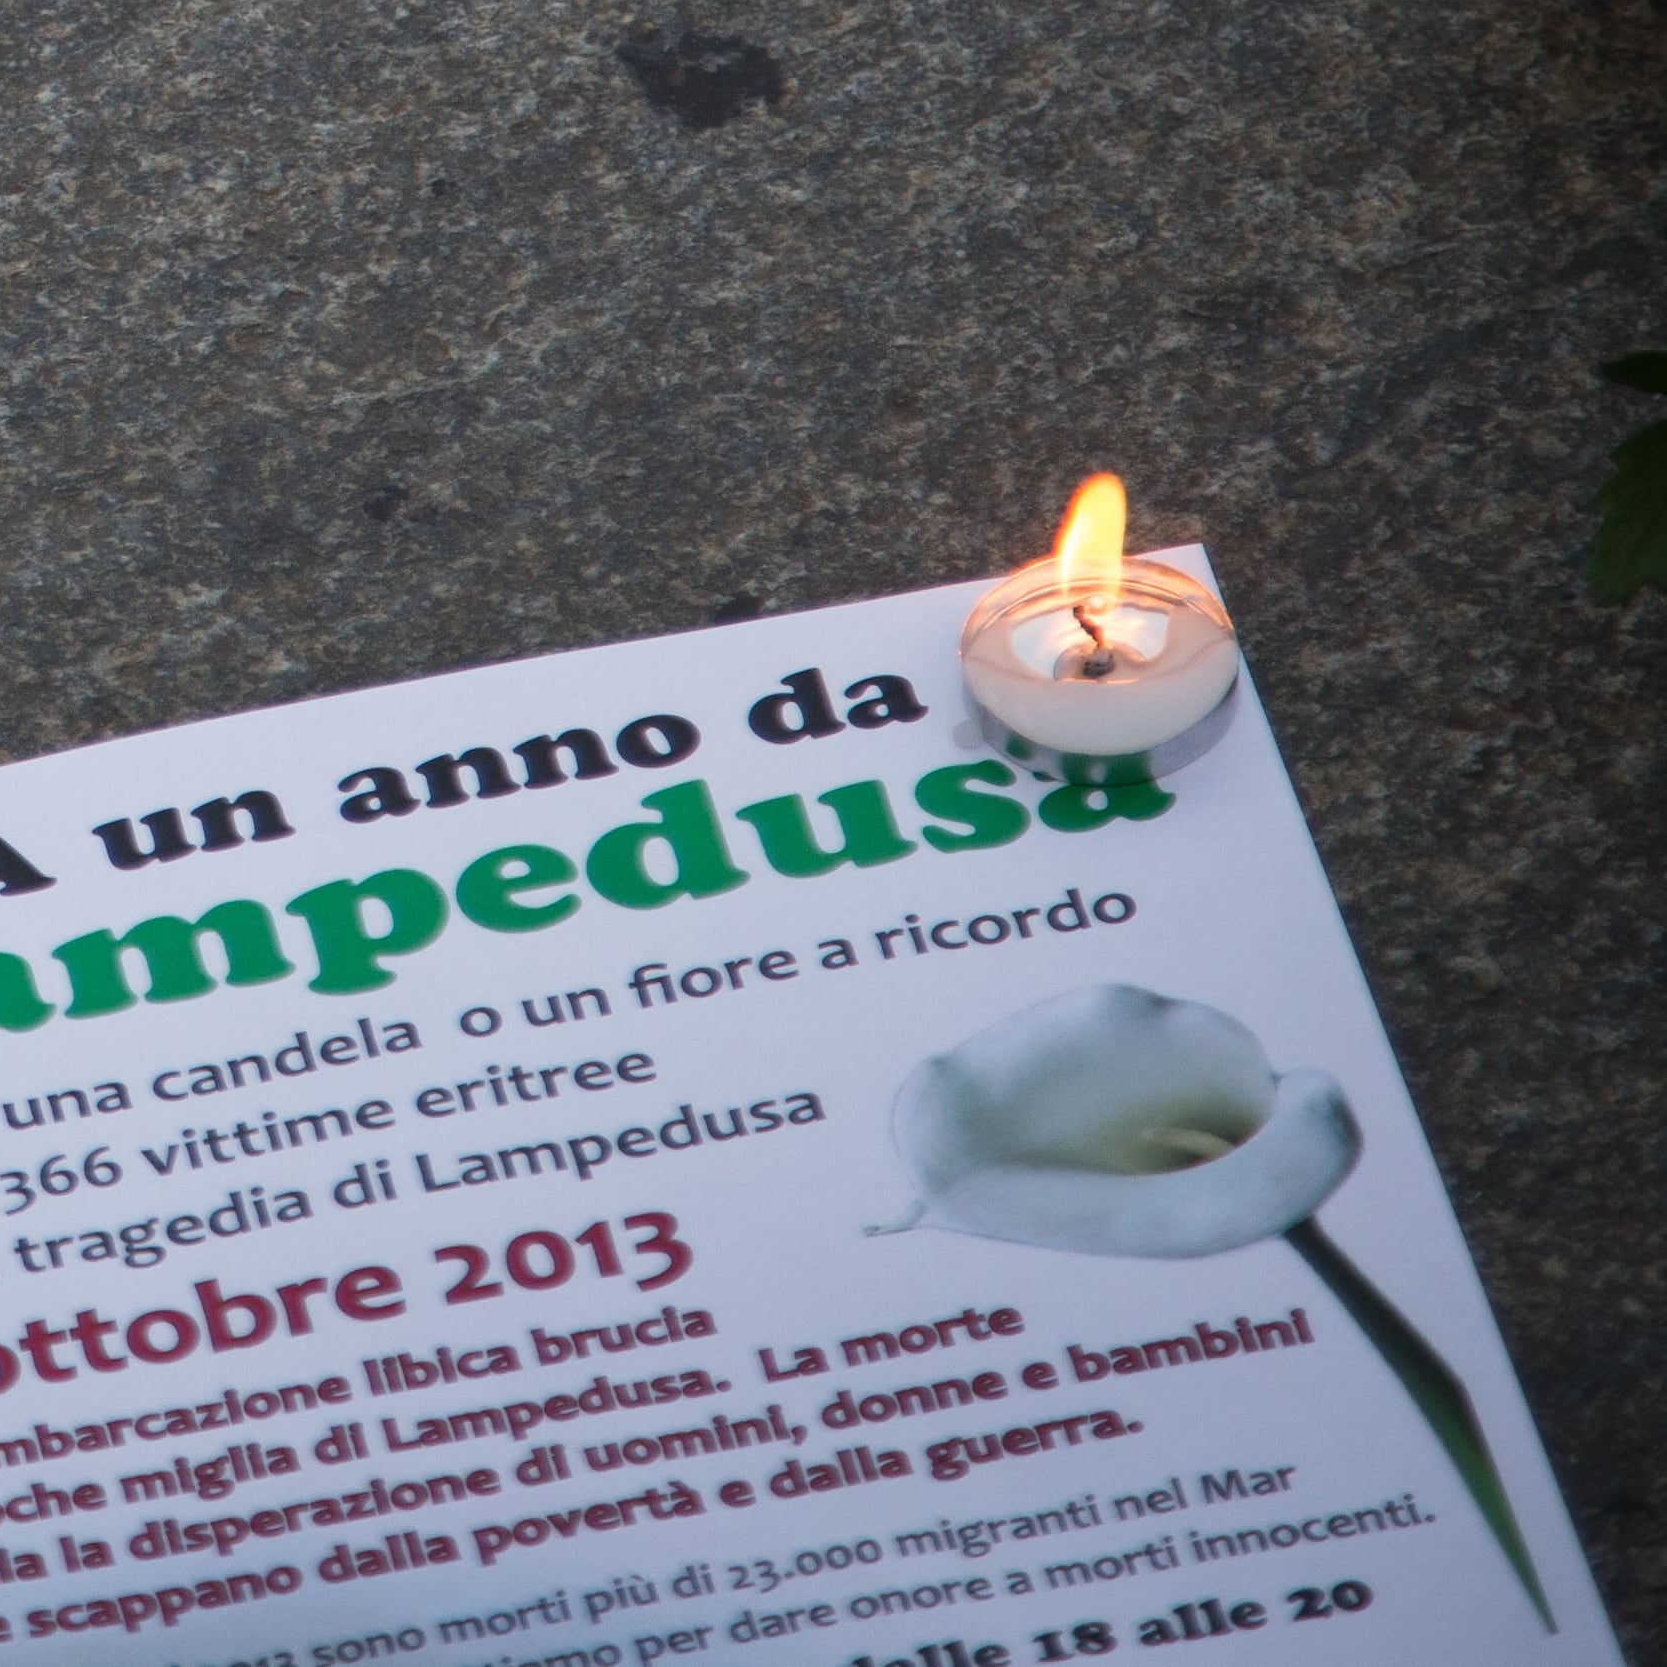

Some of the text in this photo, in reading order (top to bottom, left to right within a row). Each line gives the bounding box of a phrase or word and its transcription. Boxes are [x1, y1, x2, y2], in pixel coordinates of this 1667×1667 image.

[91, 790, 295, 870] un
[337, 714, 700, 824] anno
[746, 667, 928, 745] da
[1, 1081, 131, 1130] una
[151, 1017, 421, 1101] candela
[458, 1006, 501, 1037] o
[520, 988, 611, 1027] un
[627, 950, 798, 1008] fiore
[817, 939, 858, 969] a
[873, 888, 1136, 959] ricordo
[0, 1146, 122, 1215] 366
[140, 1100, 395, 1175] vittime
[413, 1052, 656, 1118] eritree
[13, 1186, 312, 1272] tragedia
[332, 1163, 396, 1208] di
[414, 1092, 825, 1192] Lampedusa
[362, 1346, 520, 1395] libica
[530, 1306, 716, 1365] brucia
[433, 1211, 692, 1305] 2013
[59, 1537, 110, 1571] la
[130, 1469, 499, 1559] disperazione
[516, 1444, 568, 1485] di
[583, 1404, 806, 1471] uomini,
[821, 1371, 1007, 1429] donne
[1021, 1362, 1057, 1390] e
[1066, 1308, 1313, 1382] bambini
[119, 1443, 297, 1502] miglia
[315, 1423, 366, 1464] di
[381, 1370, 731, 1451] Lampedusa.
[758, 1347, 828, 1382] La
[839, 1308, 1023, 1366] morte
[27, 1567, 299, 1636] scappano
[319, 1532, 457, 1582] dalla
[473, 1481, 703, 1564] povertà
[719, 1481, 753, 1507] e
[769, 1446, 911, 1498] dalla
[924, 1410, 1142, 1481] guerra.
[310, 1628, 423, 1667] sono
[439, 1598, 567, 1640] morti
[583, 1579, 656, 1622] più
[672, 1564, 712, 1597] di
[729, 1539, 880, 1592] 23.000
[895, 1494, 1100, 1557] migranti
[1112, 1478, 1186, 1519] nel
[1198, 1467, 1294, 1503] Mar
[634, 1627, 712, 1667] per
[728, 1604, 833, 1642] dare
[849, 1578, 992, 1618] onore
[1006, 1571, 1031, 1594] a
[1044, 1536, 1177, 1587] morti
[1189, 1494, 1434, 1561] innocenti.
[1033, 1620, 1116, 1662] 18
[1137, 1598, 1266, 1646] alle
[1286, 1580, 1372, 1621] 20
